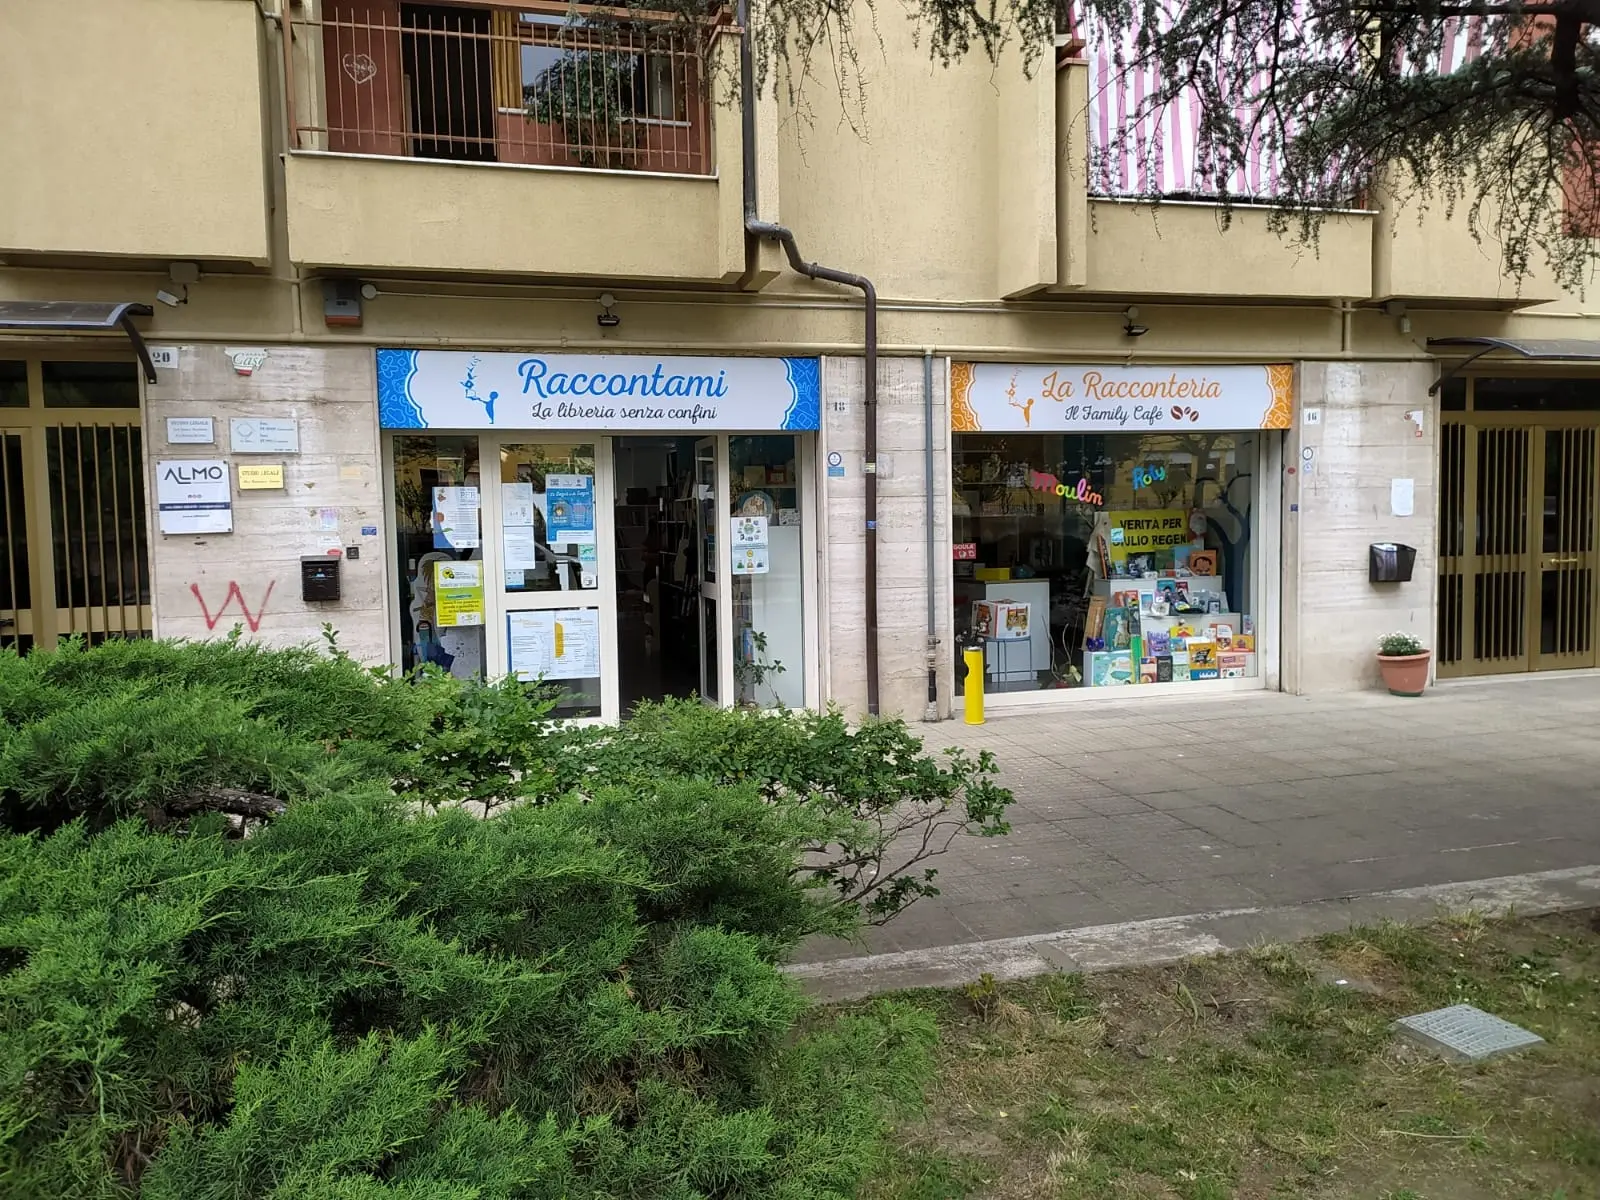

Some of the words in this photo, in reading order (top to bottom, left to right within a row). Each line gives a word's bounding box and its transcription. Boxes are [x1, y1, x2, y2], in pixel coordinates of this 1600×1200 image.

[152, 352, 170, 363] 20
[517, 358, 728, 398] Raccontami
[1042, 371, 1075, 402] La
[1083, 371, 1222, 401] Racconteria
[532, 402, 552, 420] La
[557, 402, 616, 418] libreria
[619, 406, 665, 418] senza
[668, 403, 717, 424] confini
[834, 401, 845, 411] 18
[1065, 405, 1080, 420] Il
[1082, 405, 1129, 425] Family
[1133, 405, 1163, 425] Café
[1307, 412, 1317, 421] 16
[164, 466, 223, 484] ALMO
[1030, 468, 1103, 506] Moulin
[1132, 464, 1166, 491] Roty
[1120, 517, 1160, 530] VERITÀ
[1162, 518, 1182, 529] PER
[1152, 534, 1191, 546] REGEN
